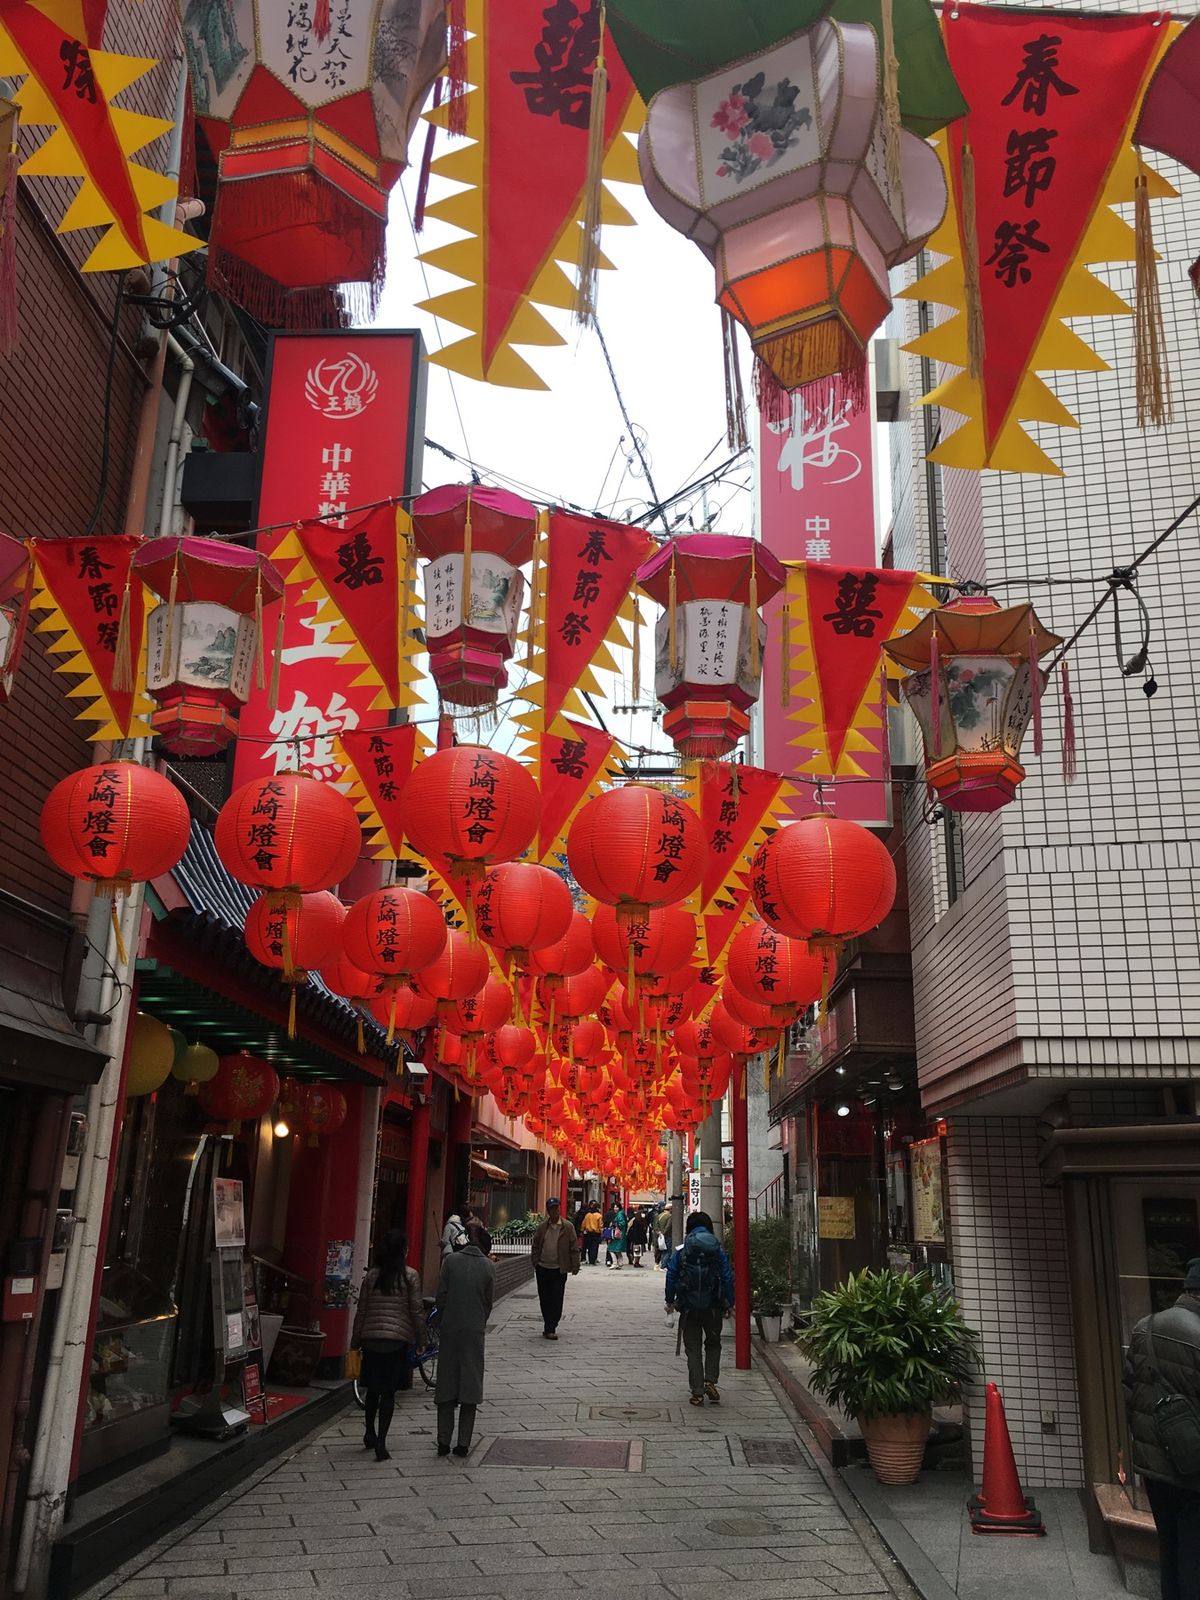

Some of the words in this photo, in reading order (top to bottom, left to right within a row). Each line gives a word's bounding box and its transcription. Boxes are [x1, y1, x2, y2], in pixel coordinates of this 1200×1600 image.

[984, 34, 1080, 288] 春節祭
[805, 515, 831, 562] 中華
[77, 546, 119, 653] 春節祭
[557, 530, 614, 647] 春節祭
[367, 735, 400, 802] 春節祭
[463, 753, 499, 845] 長崎燈會
[82, 769, 123, 858] 長崎燈會
[247, 781, 287, 871] 長崎燈會
[651, 794, 687, 884] 長崎燈會
[710, 774, 749, 854] 春節祭
[376, 895, 401, 963] 長崎燈會
[691, 1179, 700, 1212] お守り
